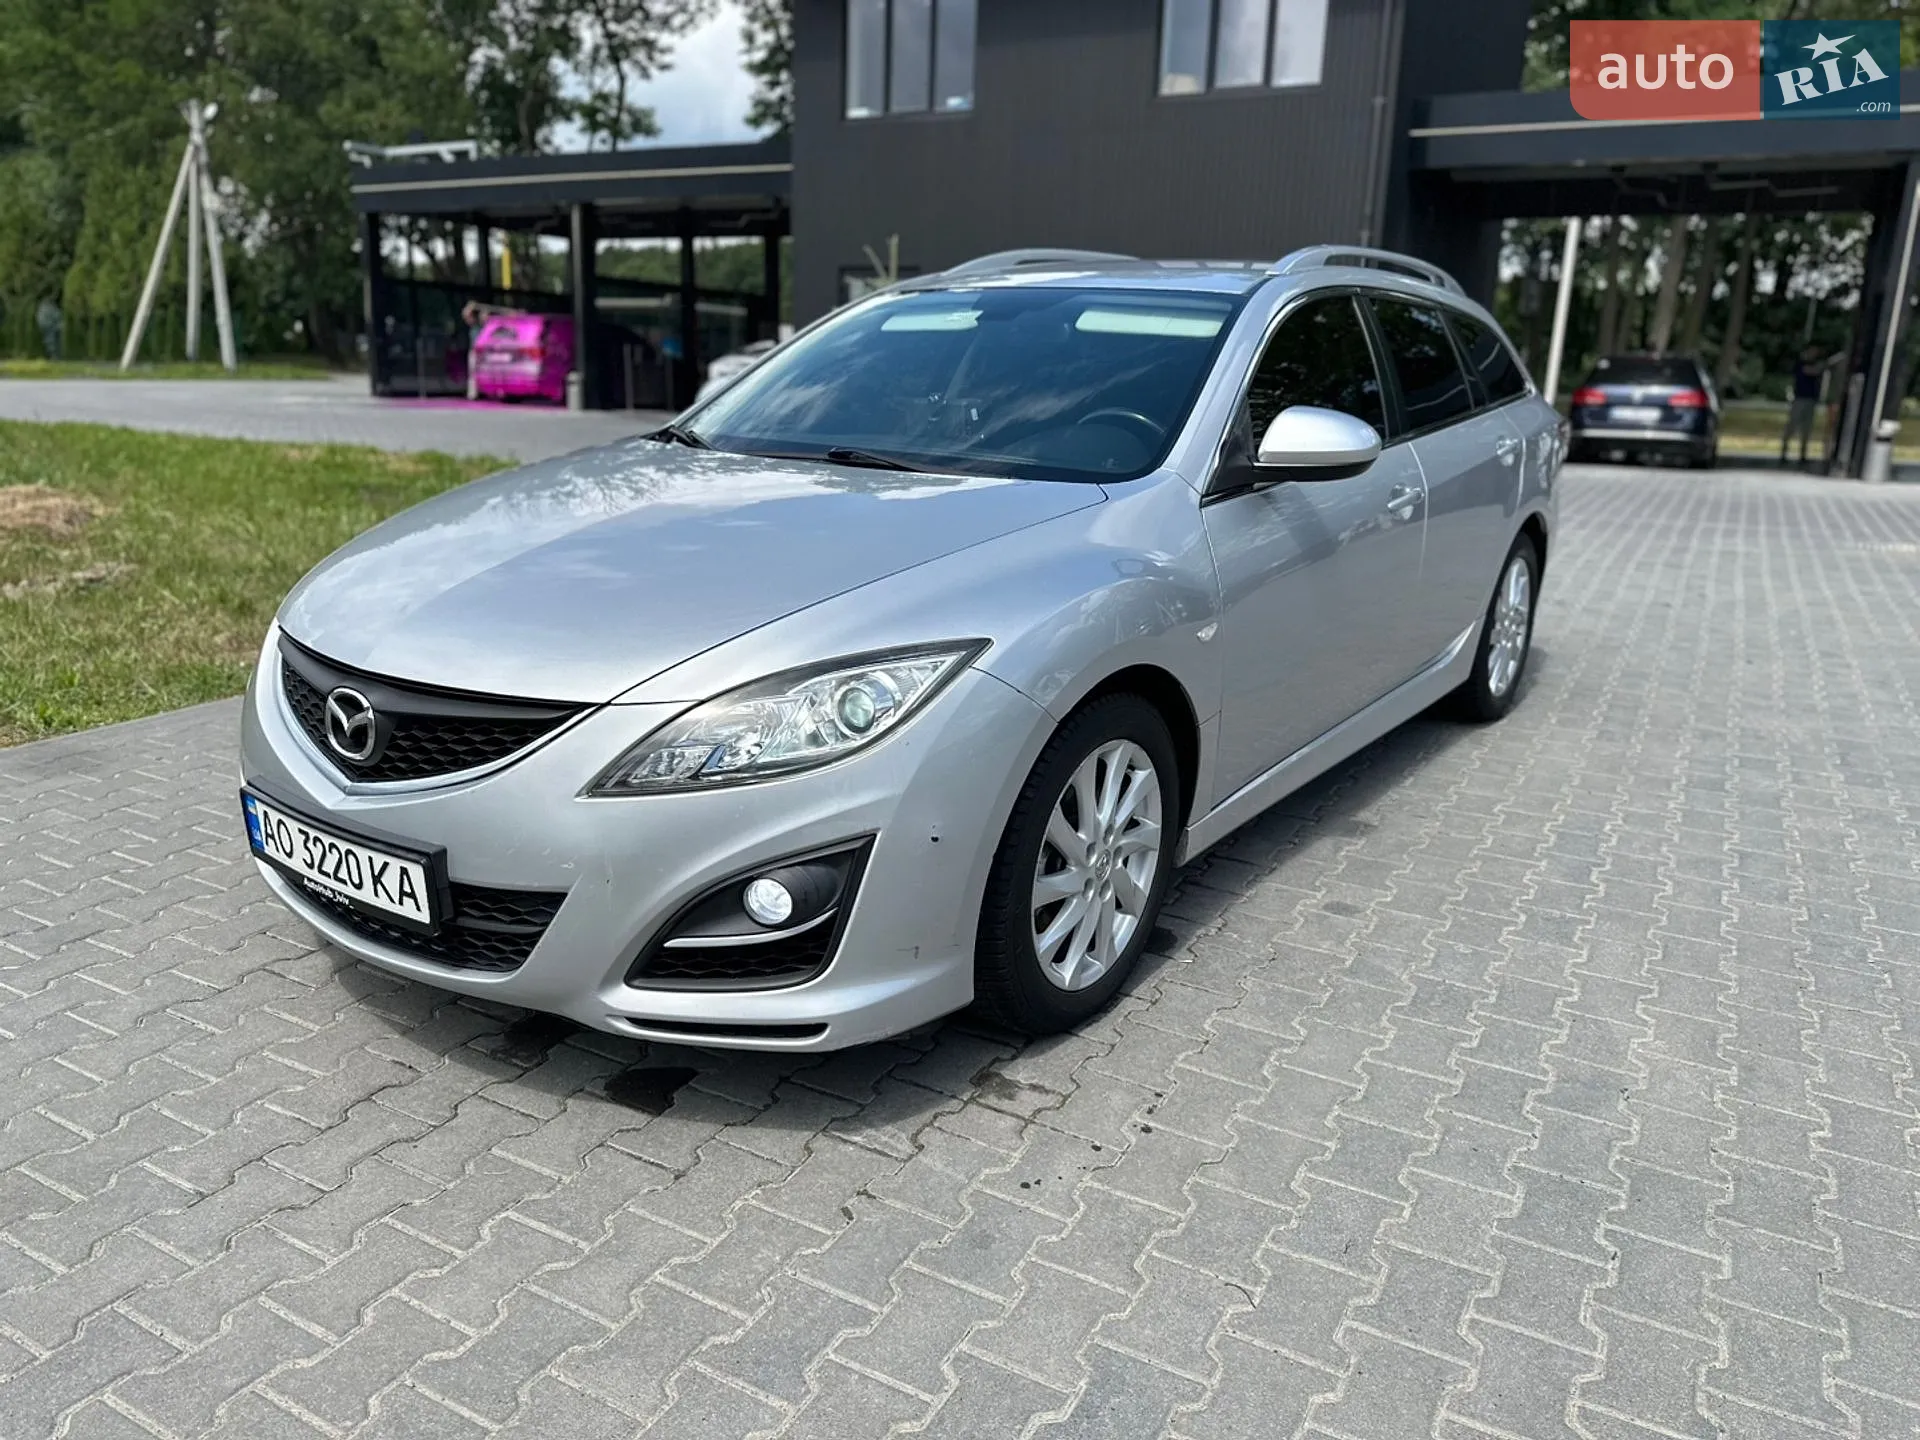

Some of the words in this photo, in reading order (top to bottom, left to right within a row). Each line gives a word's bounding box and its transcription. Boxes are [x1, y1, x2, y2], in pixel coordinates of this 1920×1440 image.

[263, 810, 293, 860] AO
[298, 828, 363, 890] 3220
[368, 855, 422, 912] KA
